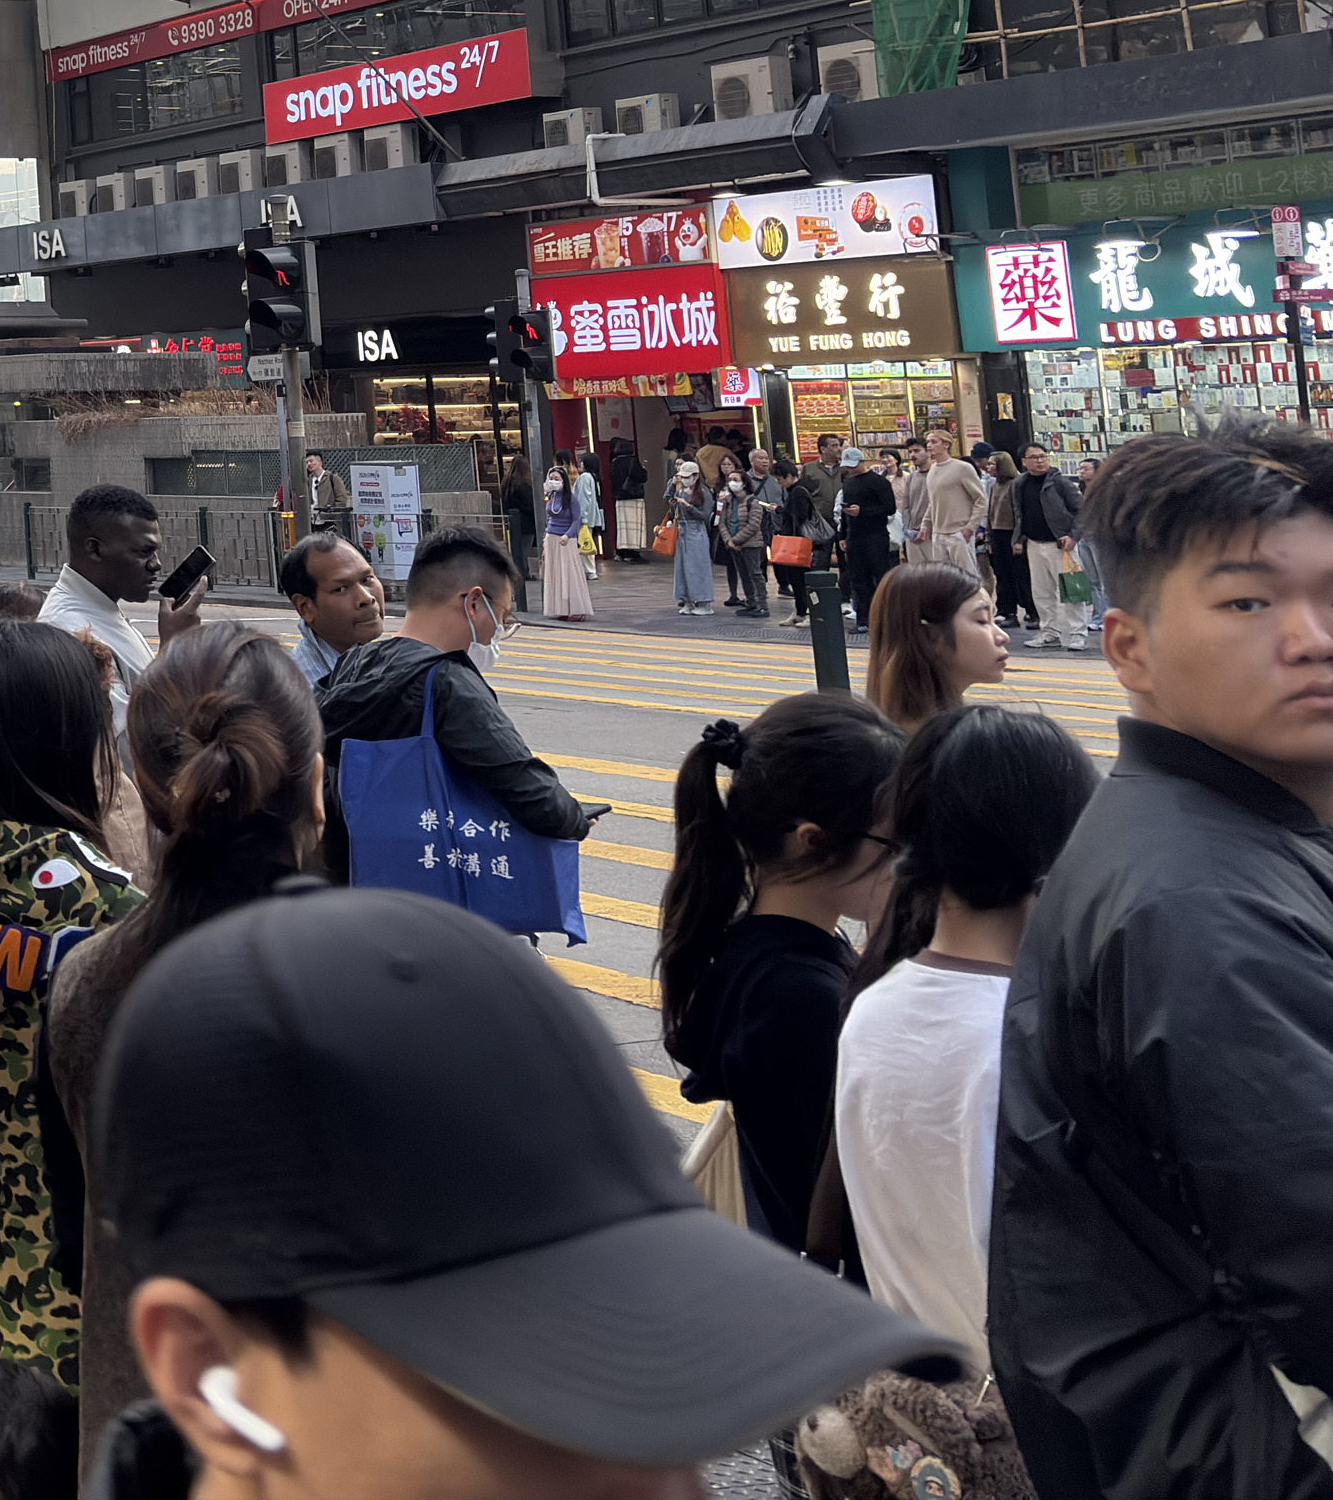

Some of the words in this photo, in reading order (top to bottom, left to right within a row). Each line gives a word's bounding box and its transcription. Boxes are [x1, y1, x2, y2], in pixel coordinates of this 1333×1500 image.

[57, 52, 87, 73] snap
[88, 40, 129, 64] fitness
[130, 32, 146, 54] 24/7
[181, 18, 215, 43] 9390
[219, 9, 253, 38] 3328
[286, 82, 354, 126] snap
[357, 61, 458, 110] fitness
[460, 40, 499, 88] 24/7
[260, 195, 303, 228] IA
[33, 228, 66, 260] ISA
[533, 233, 592, 263] 雪王推荐
[996, 253, 1065, 331] 藥
[570, 291, 719, 353] 蜜雪冰城
[1099, 318, 1177, 344] LUNG
[1198, 311, 1289, 339] SHING
[357, 329, 400, 362] ISA
[768, 335, 800, 353] YUE
[809, 333, 853, 351] FUNG
[862, 329, 910, 350] HONG
[418, 843, 514, 880] 善於溝通
